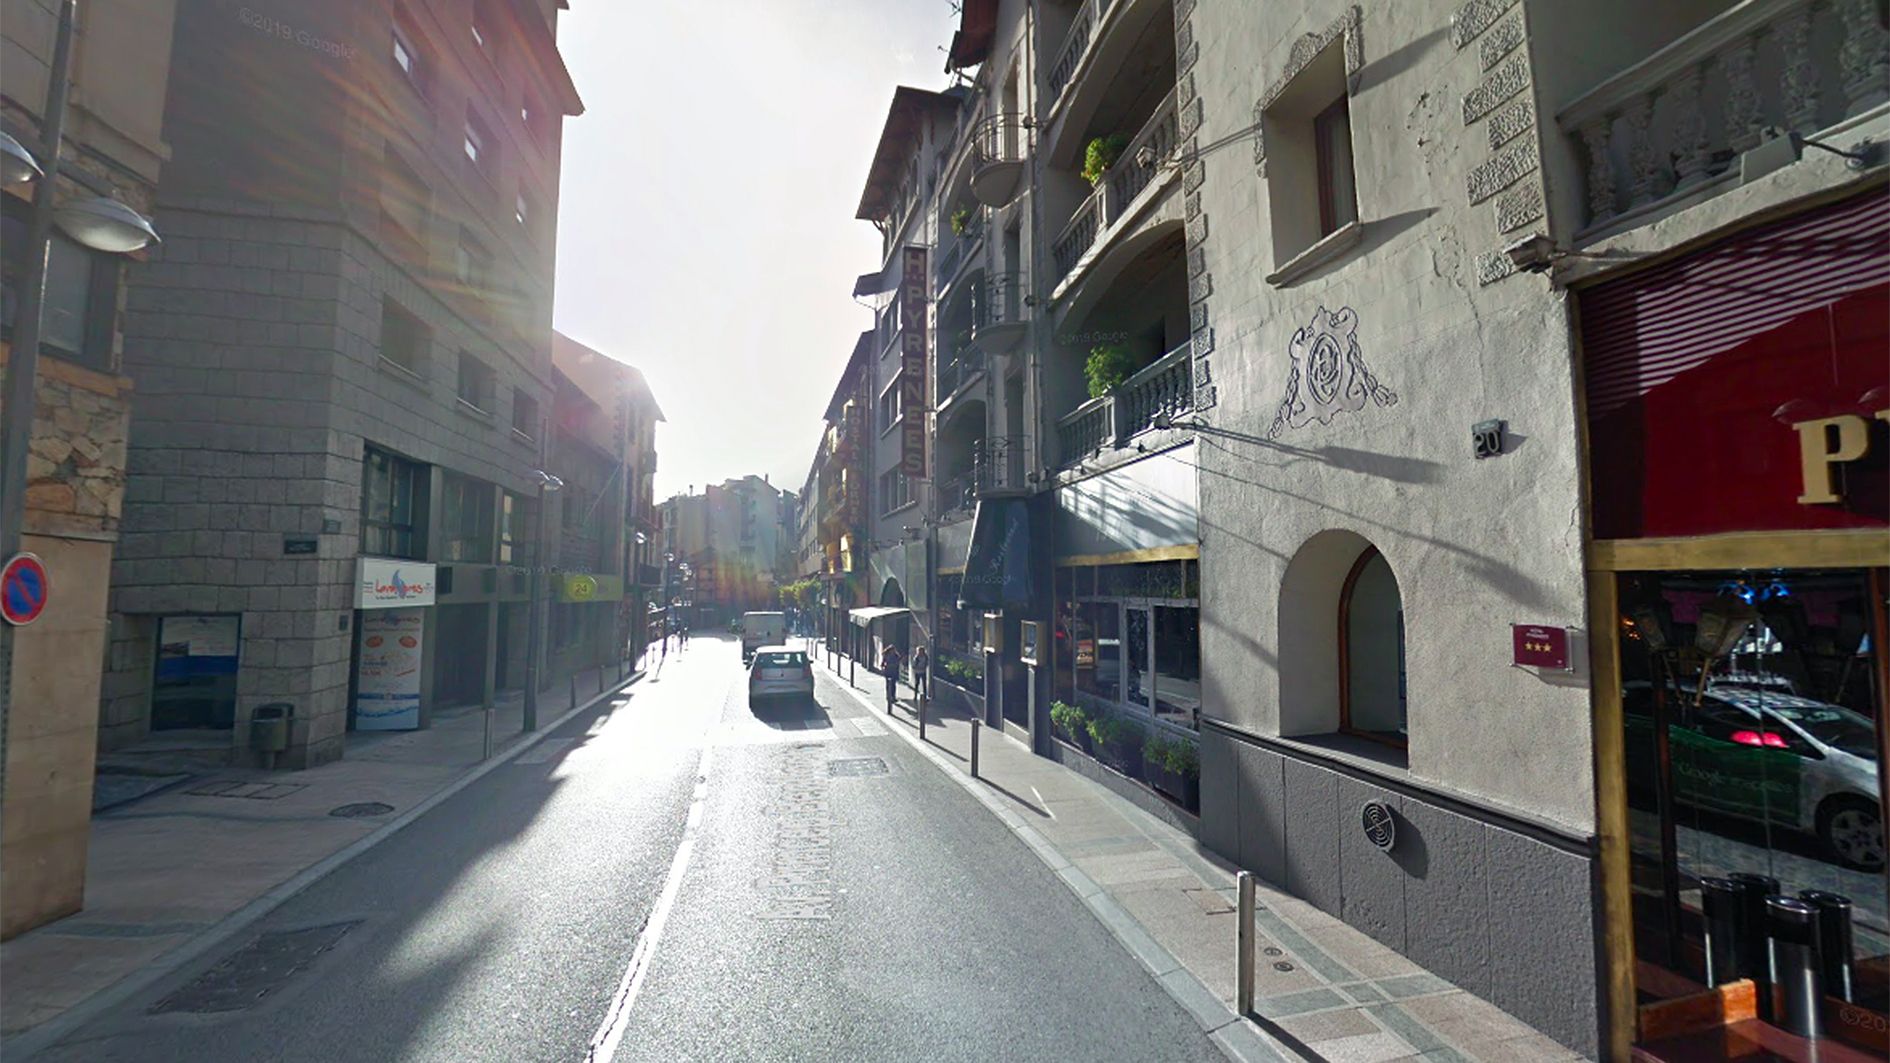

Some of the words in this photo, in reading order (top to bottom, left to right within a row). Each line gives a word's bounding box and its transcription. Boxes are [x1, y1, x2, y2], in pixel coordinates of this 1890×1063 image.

[905, 286, 923, 470] PYRENEES
[1473, 431, 1499, 455] 20
[576, 583, 588, 593] 24
